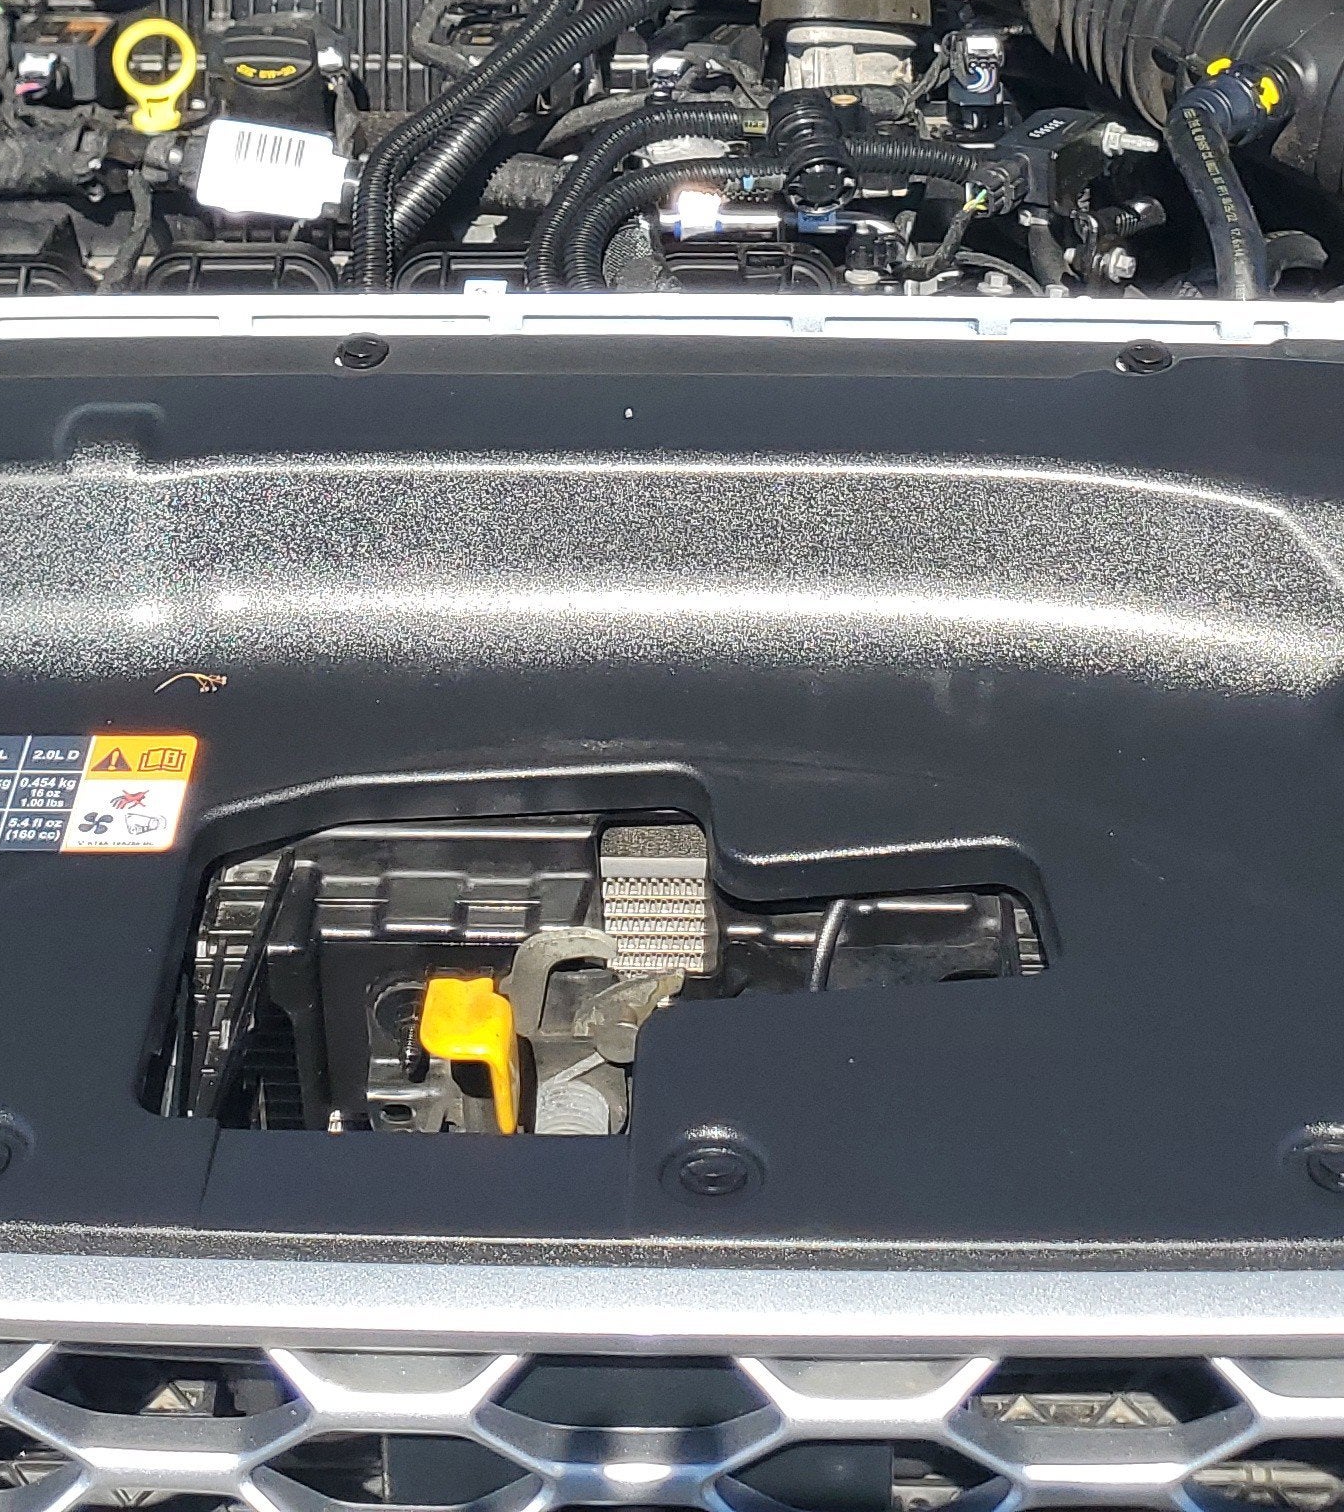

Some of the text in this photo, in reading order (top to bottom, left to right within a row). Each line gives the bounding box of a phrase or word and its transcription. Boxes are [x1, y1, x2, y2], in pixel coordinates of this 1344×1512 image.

[32, 750, 80, 760] 2.0L D
[20, 777, 76, 790] 0.454 kg
[30, 789, 61, 798] 16 oz
[20, 798, 64, 807] 1.00 lbs
[32, 818, 43, 827] fl
[46, 819, 63, 828] oz
[38, 829, 61, 841] cc)
